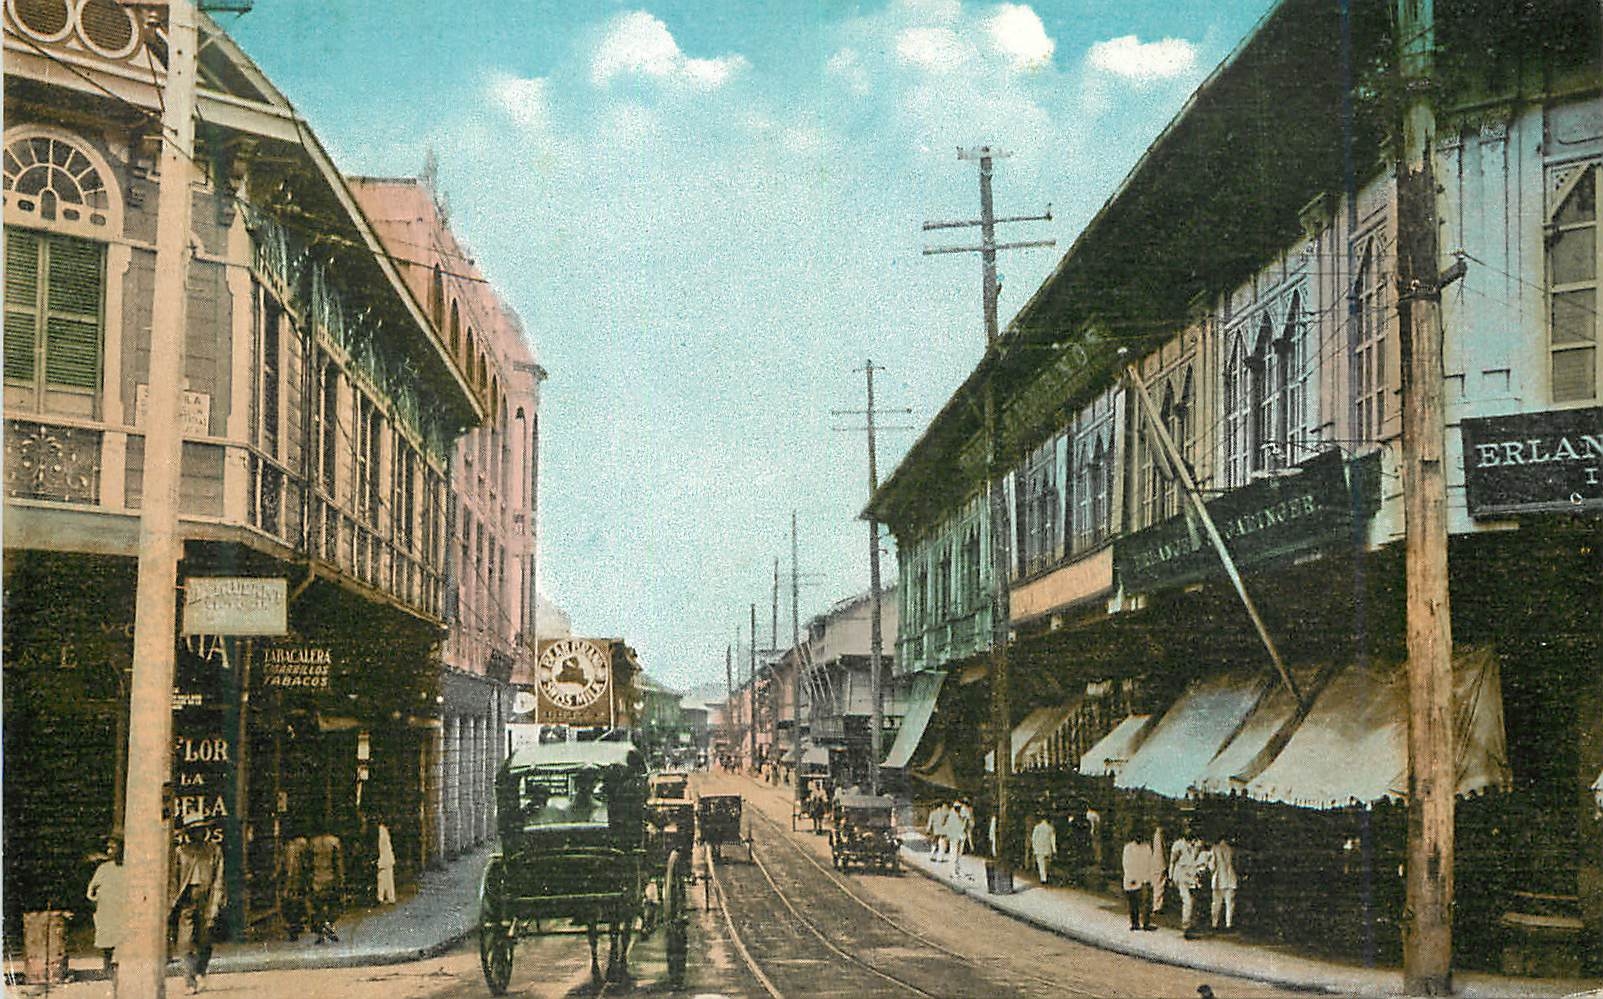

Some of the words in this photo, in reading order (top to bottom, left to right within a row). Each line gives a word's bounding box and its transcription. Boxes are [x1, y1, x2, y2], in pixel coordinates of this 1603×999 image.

[1475, 433, 1603, 468] ERLAN
[264, 648, 332, 664] TABACALERA
[264, 675, 329, 687] TABACOS
